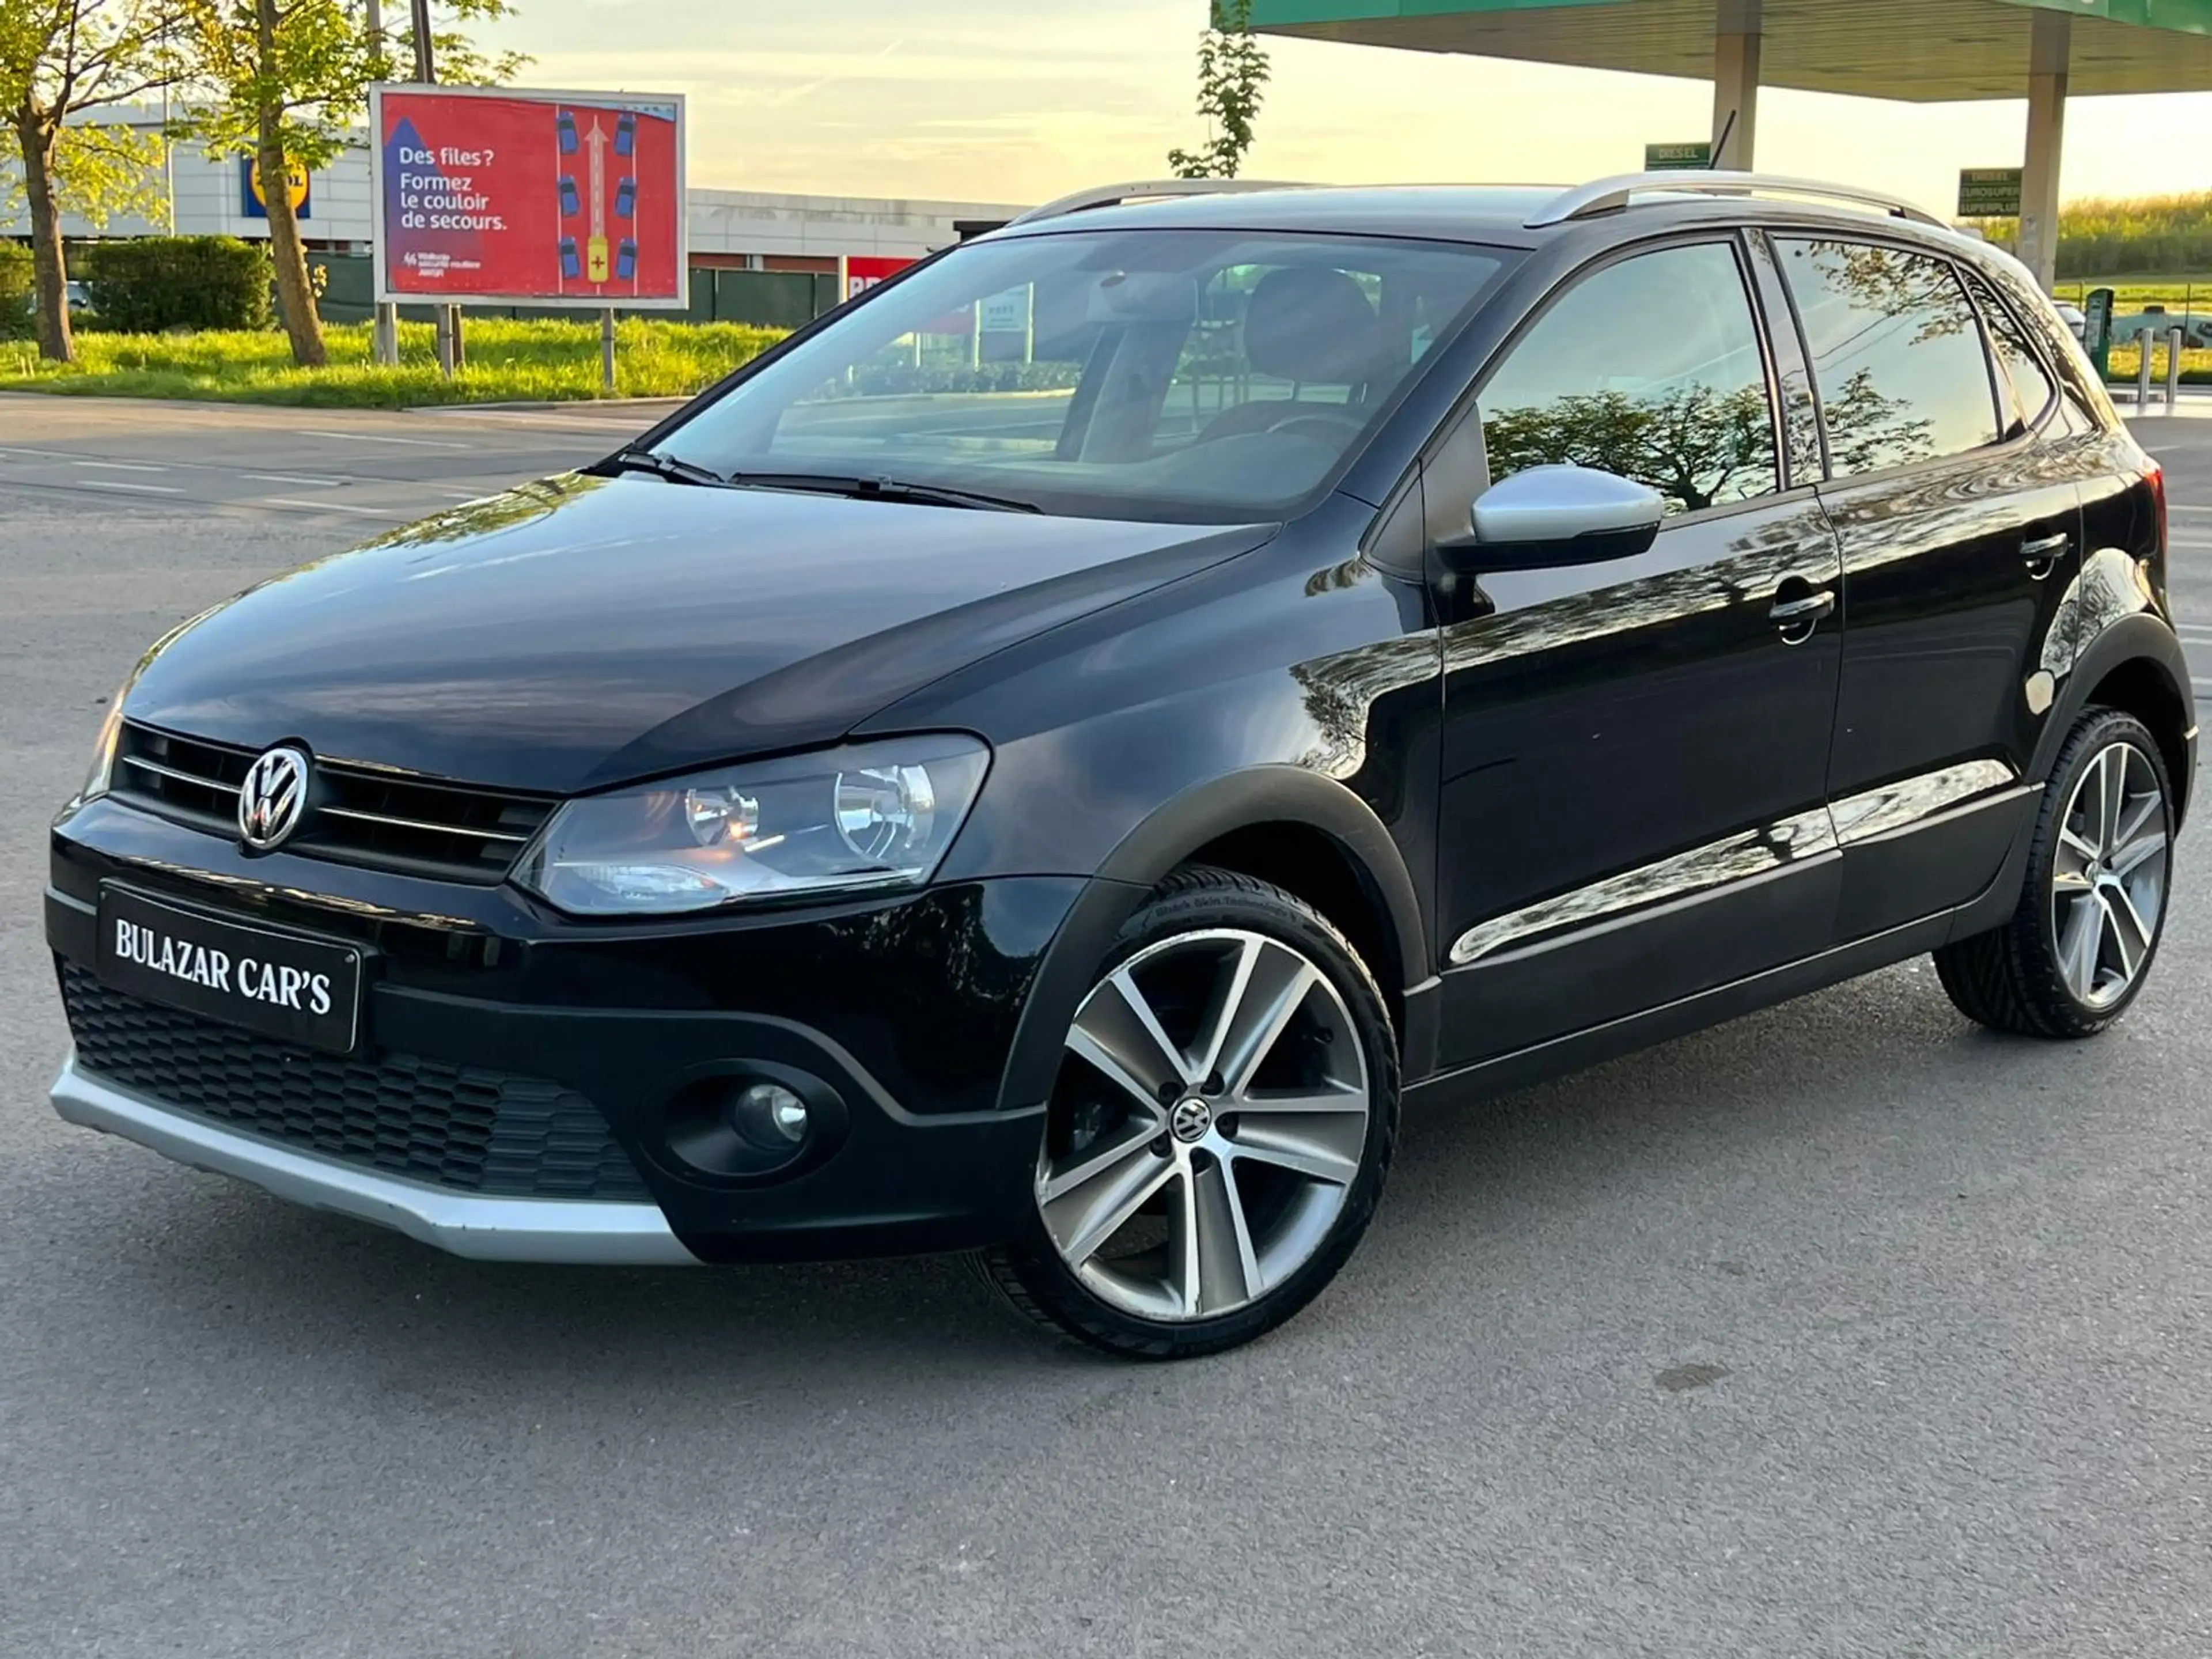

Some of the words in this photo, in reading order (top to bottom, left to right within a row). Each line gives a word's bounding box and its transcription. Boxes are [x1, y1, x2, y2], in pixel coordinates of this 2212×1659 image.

[399, 147, 435, 165] Des
[1659, 146, 1698, 160] DIESEL
[400, 172, 472, 191] Formez
[401, 191, 419, 209] le
[423, 192, 490, 210] couloir
[402, 211, 425, 229] de
[430, 214, 507, 230] secours.
[1194, 896, 1221, 908] Skin
[116, 918, 230, 993] BULAZAR
[237, 958, 331, 1015] CAR'S
